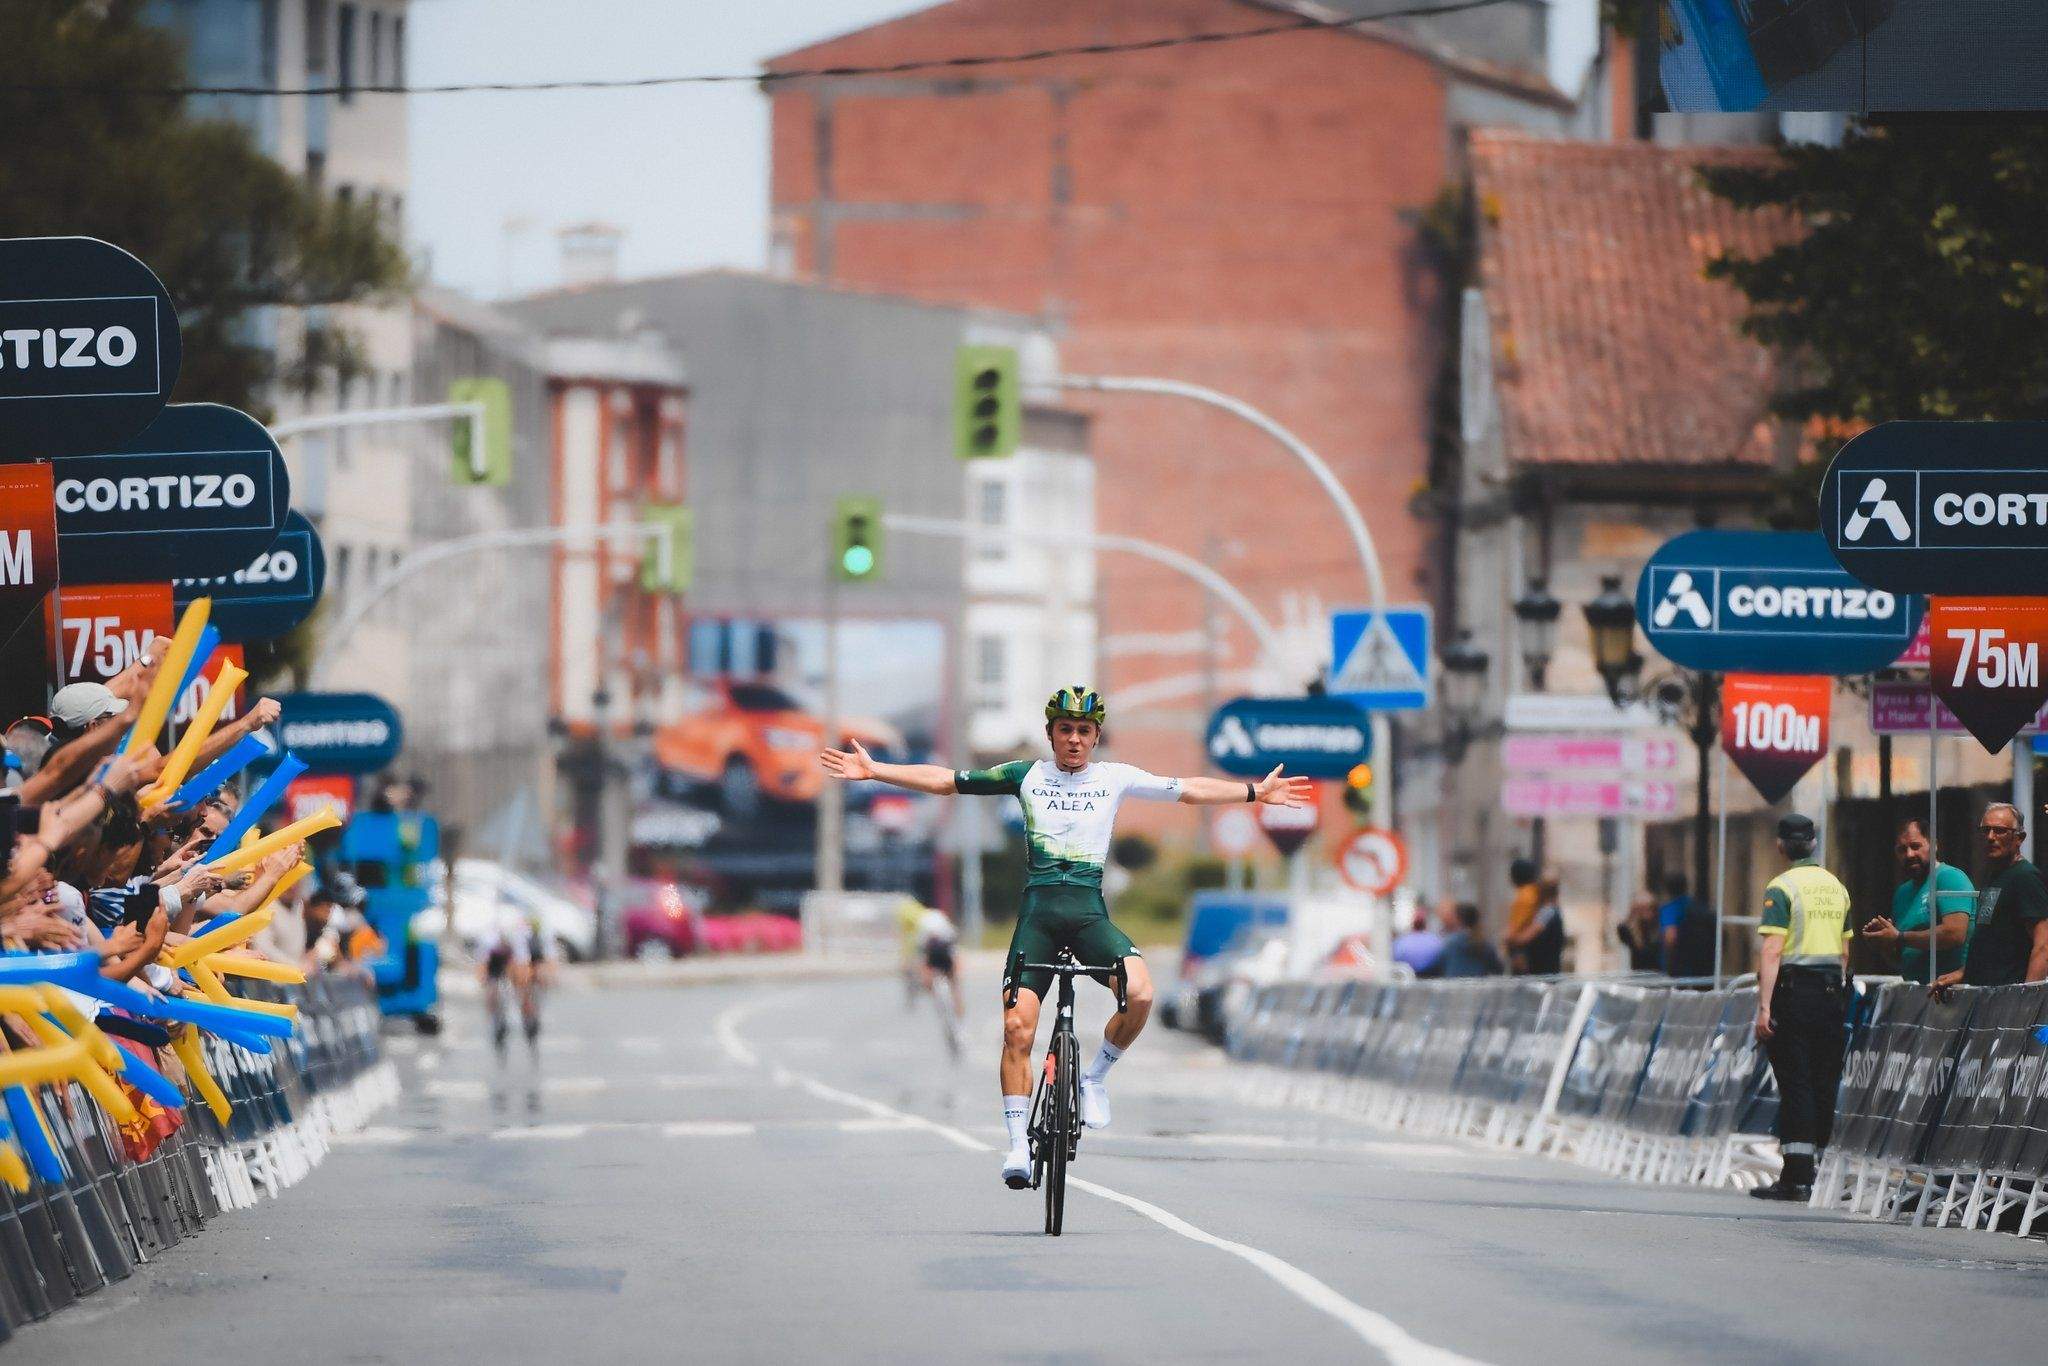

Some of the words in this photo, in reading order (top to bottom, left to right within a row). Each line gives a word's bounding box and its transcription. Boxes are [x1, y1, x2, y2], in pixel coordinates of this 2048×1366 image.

[0, 326, 137, 368] TIZO
[55, 474, 255, 513] CORTIZO
[1934, 493, 2048, 526] CORT
[0, 529, 33, 585] M
[1728, 585, 1895, 620] CORTIZO
[62, 615, 155, 678] 75M
[1947, 628, 2039, 689] 75M
[1732, 701, 1820, 752] 100M
[1047, 800, 1095, 811] ALEA
